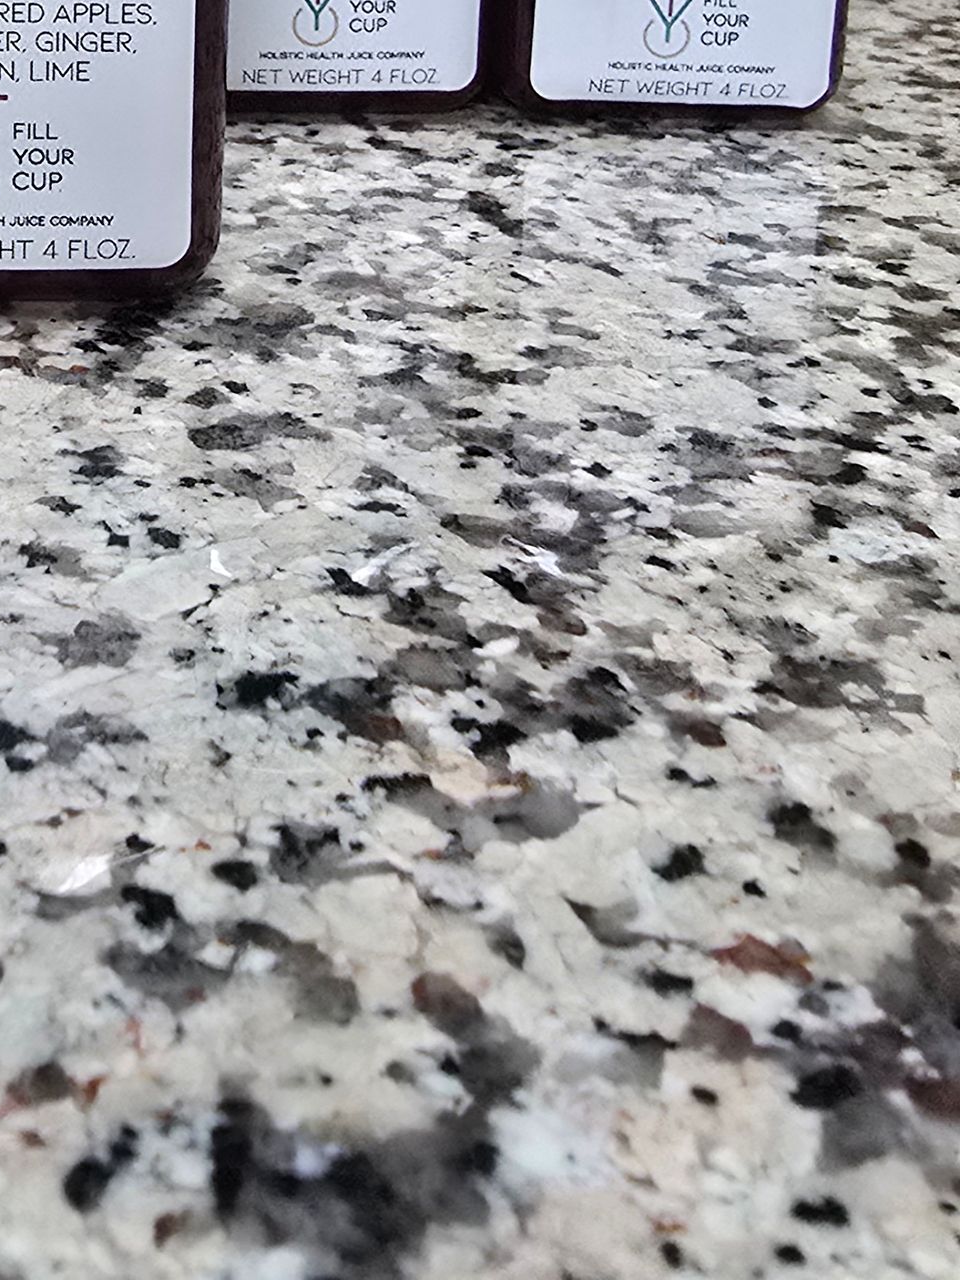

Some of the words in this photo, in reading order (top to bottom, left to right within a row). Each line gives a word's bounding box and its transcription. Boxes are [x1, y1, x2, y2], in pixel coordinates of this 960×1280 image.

[53, 3, 157, 25] APPLES,
[349, 0, 396, 14] YOUR
[349, 17, 388, 33] CUP
[703, 13, 749, 27] YOUR
[35, 31, 137, 54] GINGER,
[700, 31, 739, 46] CUP
[30, 60, 90, 82] LIME
[242, 69, 282, 85] NET
[289, 69, 364, 85] WEIGHT
[371, 69, 382, 83] 4
[589, 79, 630, 93] NET
[637, 80, 713, 96] WEIGHT
[719, 83, 731, 96] 4
[13, 123, 58, 140] FILL
[12, 148, 74, 165] YOUR
[12, 171, 63, 192] CUP
[9, 216, 45, 227] JUICE
[49, 215, 114, 227] COMPANY
[43, 240, 59, 259] 4
